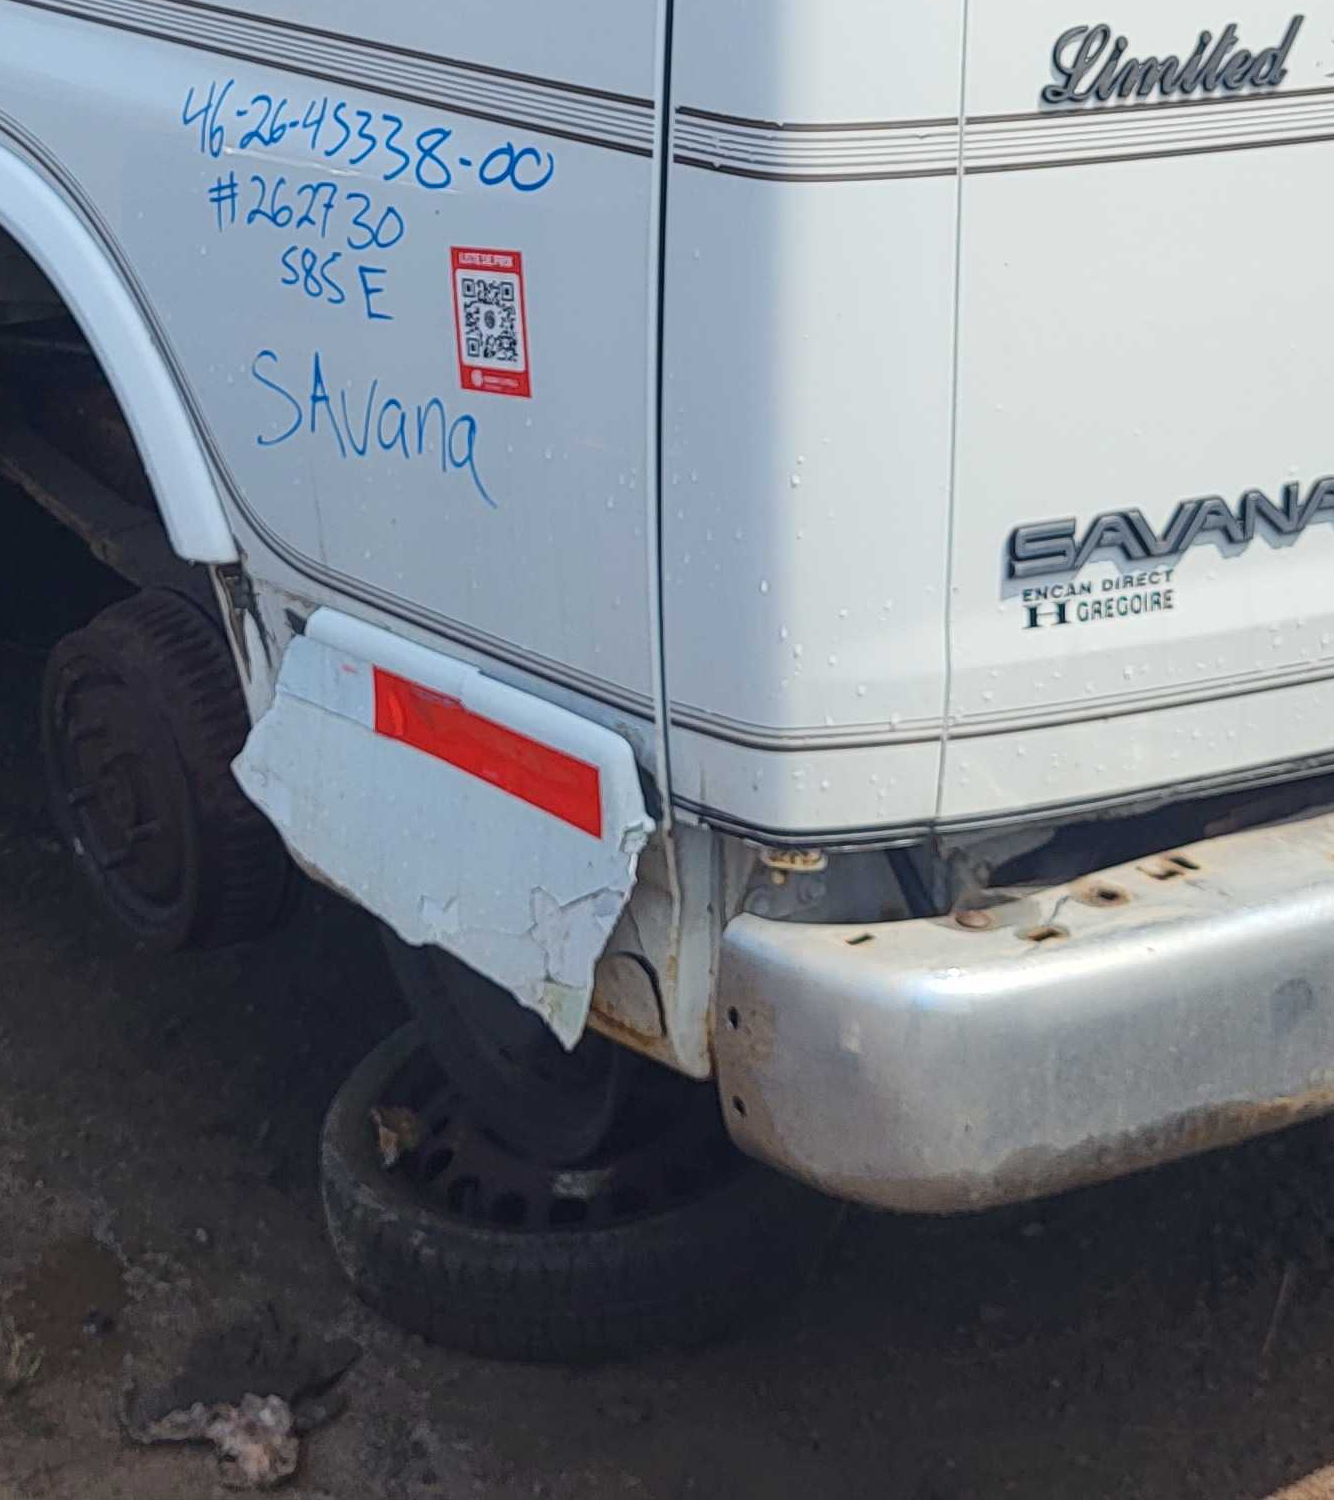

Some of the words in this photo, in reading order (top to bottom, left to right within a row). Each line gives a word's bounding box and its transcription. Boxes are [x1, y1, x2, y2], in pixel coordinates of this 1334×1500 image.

[1041, 14, 1305, 105] Limited
[182, 78, 555, 192] 46-26-45338-00
[208, 170, 405, 250] #262730
[1021, 599, 1072, 630] H
[1075, 590, 1175, 623] GREGOIRE
[1022, 581, 1092, 602] ENCAN
[1101, 569, 1175, 592] DIRECT
